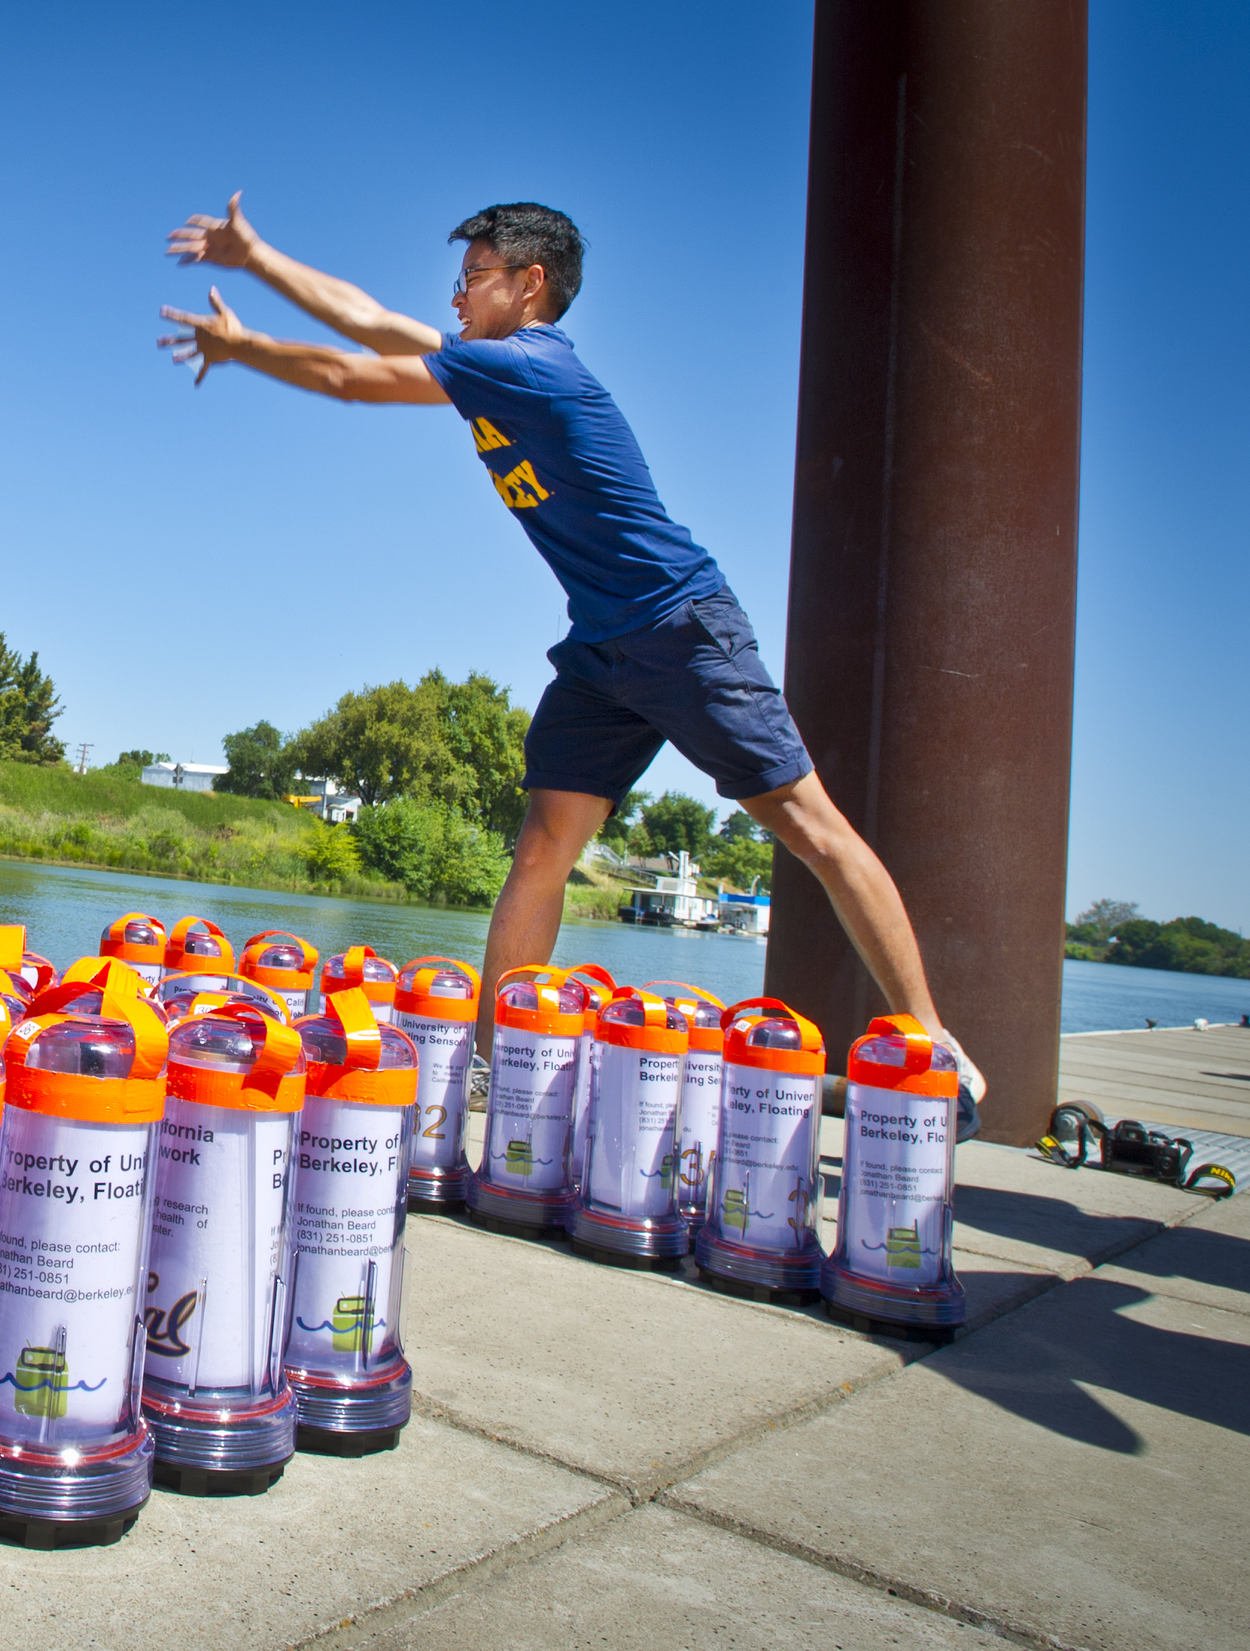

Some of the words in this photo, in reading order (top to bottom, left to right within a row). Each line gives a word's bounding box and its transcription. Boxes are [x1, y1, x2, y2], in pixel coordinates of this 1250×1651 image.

[402, 1018, 450, 1034] University
[408, 1032, 426, 1044] ting
[501, 1045, 536, 1058] roperty
[541, 1048, 553, 1058] of
[501, 1057, 540, 1072] erkeley,
[756, 1088, 770, 1099] of
[759, 1103, 810, 1118] Floating
[860, 1110, 917, 1128] Property
[924, 1117, 936, 1127] of
[300, 1131, 378, 1154] Property
[386, 1134, 399, 1150] of
[860, 1126, 923, 1144] Berkeley,
[90, 1156, 112, 1174] of
[300, 1154, 383, 1176] Berkeley,
[894, 1174, 919, 1182] Beard
[1210, 1167, 1236, 1187] Nik
[880, 1181, 917, 1192] 251-0851
[163, 1198, 208, 1215] research
[298, 1203, 304, 1212] If
[306, 1204, 338, 1218] found,
[342, 1208, 374, 1218] please
[156, 1210, 184, 1226] health
[196, 1218, 208, 1229] of
[297, 1216, 344, 1230] Jonathan
[348, 1220, 376, 1230] Beard
[296, 1230, 323, 1243] (831)
[326, 1234, 374, 1244] 251-0851
[31, 1240, 72, 1254] please
[76, 1242, 120, 1254] contact:
[37, 1256, 74, 1269] Beard
[14, 1267, 70, 1285] 251-0851
